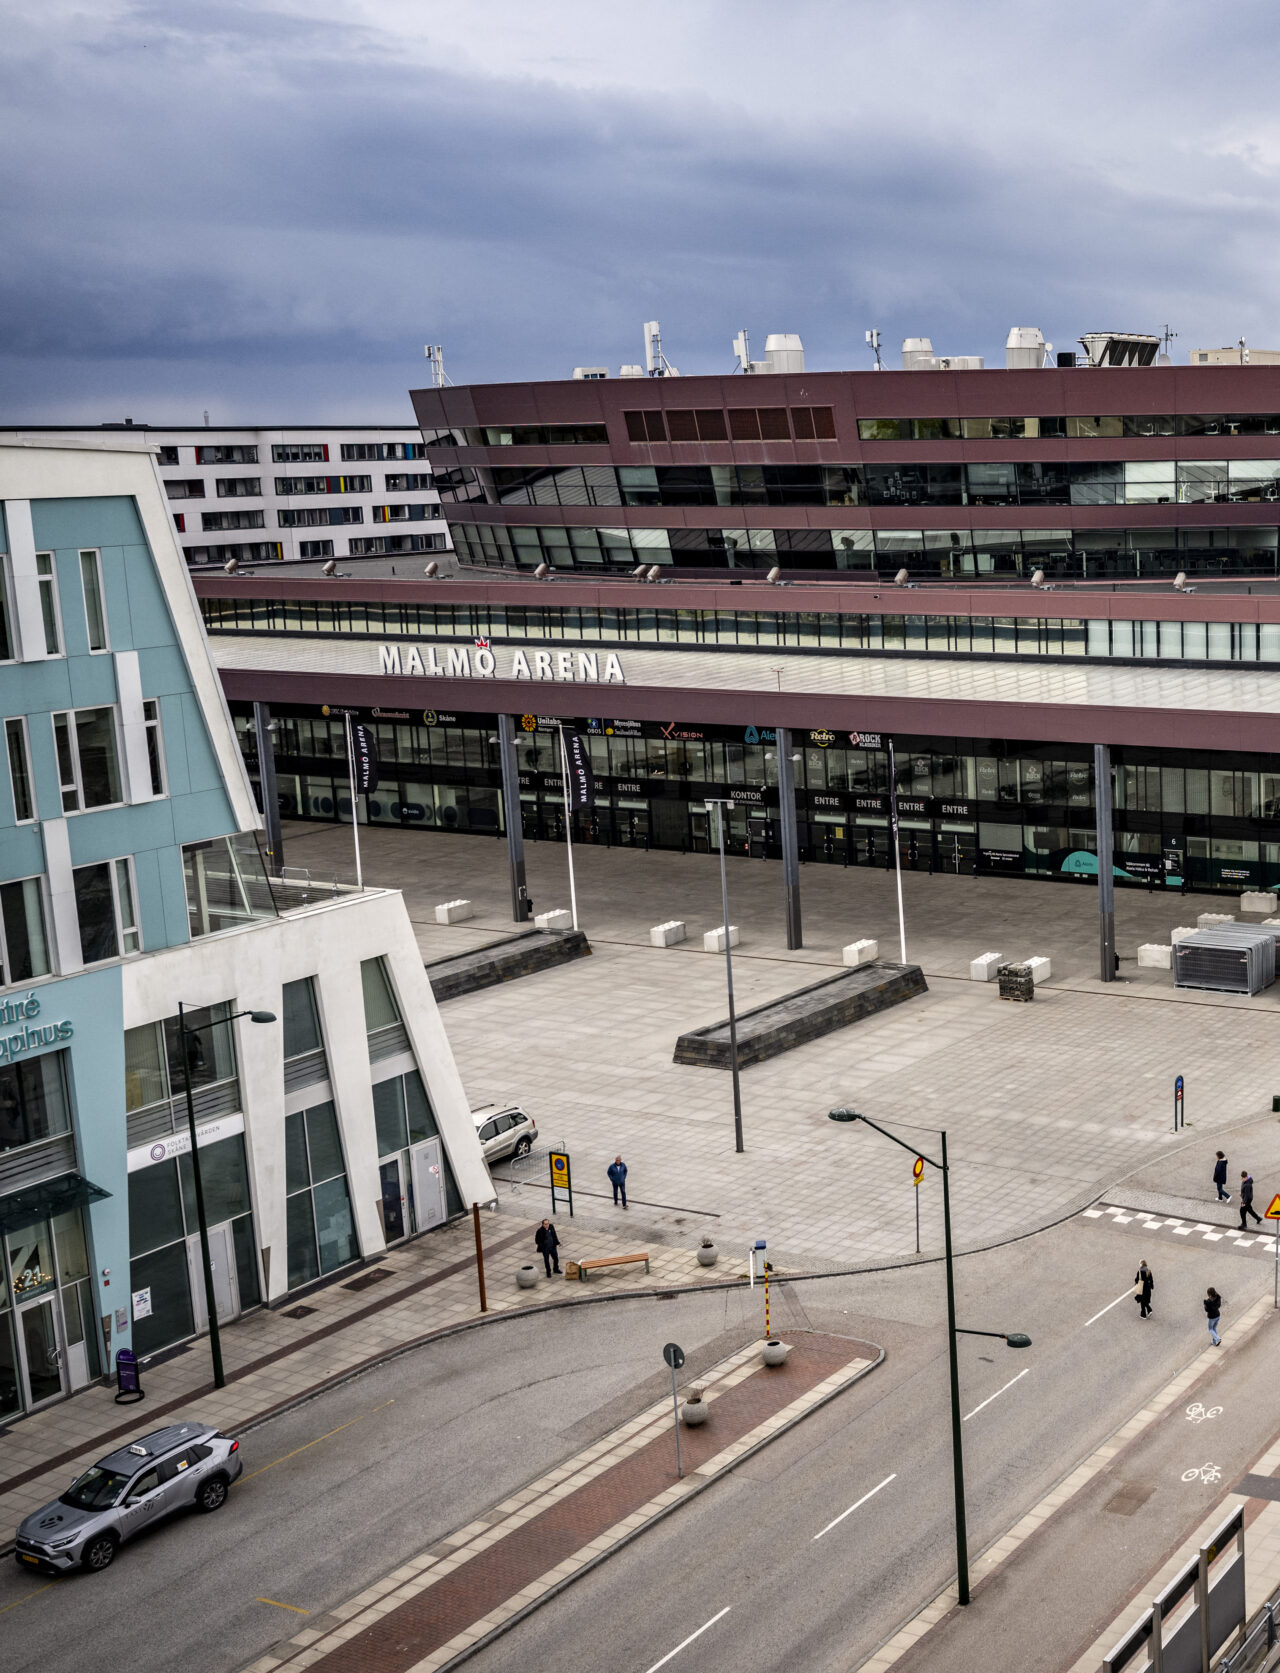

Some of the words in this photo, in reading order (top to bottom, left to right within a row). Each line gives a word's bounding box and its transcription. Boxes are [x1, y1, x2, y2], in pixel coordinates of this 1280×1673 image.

[512, 650, 625, 682] ARENA
[357, 725, 368, 754] ARENA
[760, 730, 777, 740] Aler
[810, 731, 836, 741] Retro
[859, 733, 881, 744] ROCK
[572, 736, 583, 766] ARENA
[730, 790, 762, 800] KONTOR
[166, 1125, 220, 1148] FOLKTAVÅRDEN
[23, 1265, 41, 1288] 21
